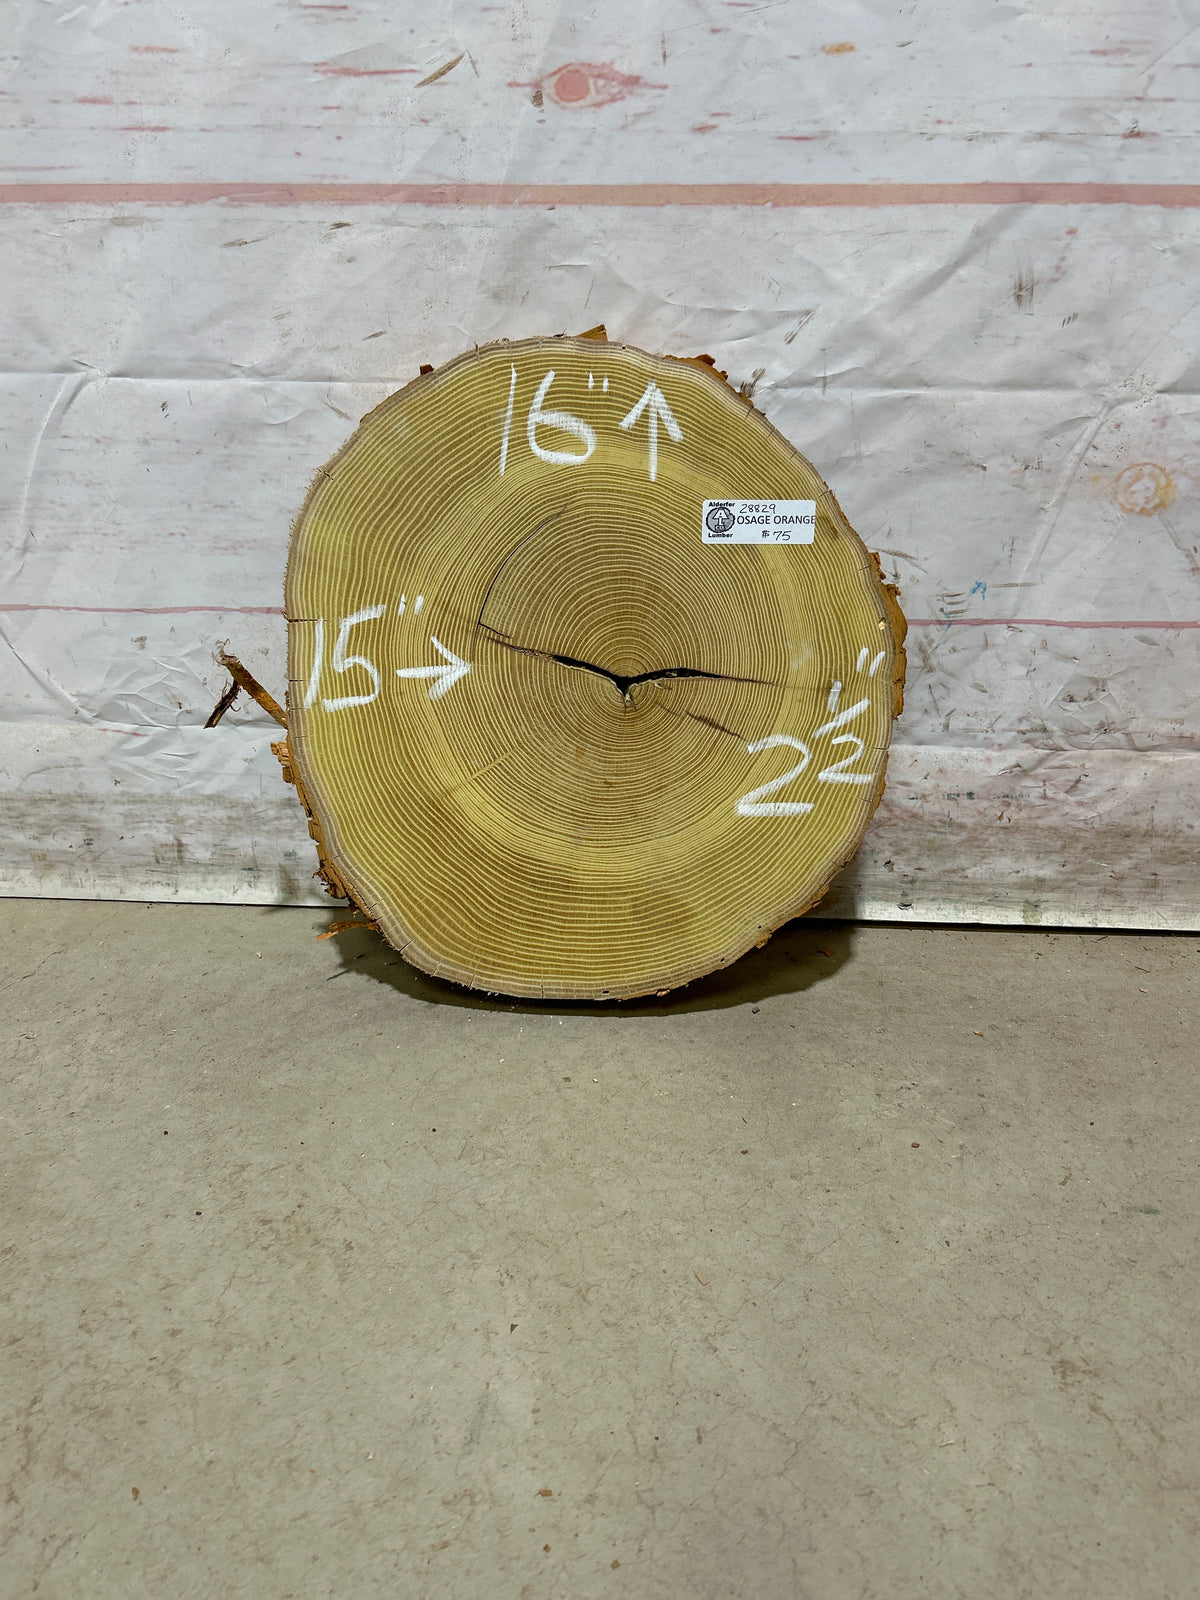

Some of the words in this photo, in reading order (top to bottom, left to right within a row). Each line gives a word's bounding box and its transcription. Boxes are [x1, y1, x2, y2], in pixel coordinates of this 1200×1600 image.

[500, 362, 609, 477] 16"
[736, 515, 771, 525] OSAGE
[773, 515, 816, 525] ORANGE
[739, 503, 776, 514] 28829
[303, 593, 424, 712] 15"
